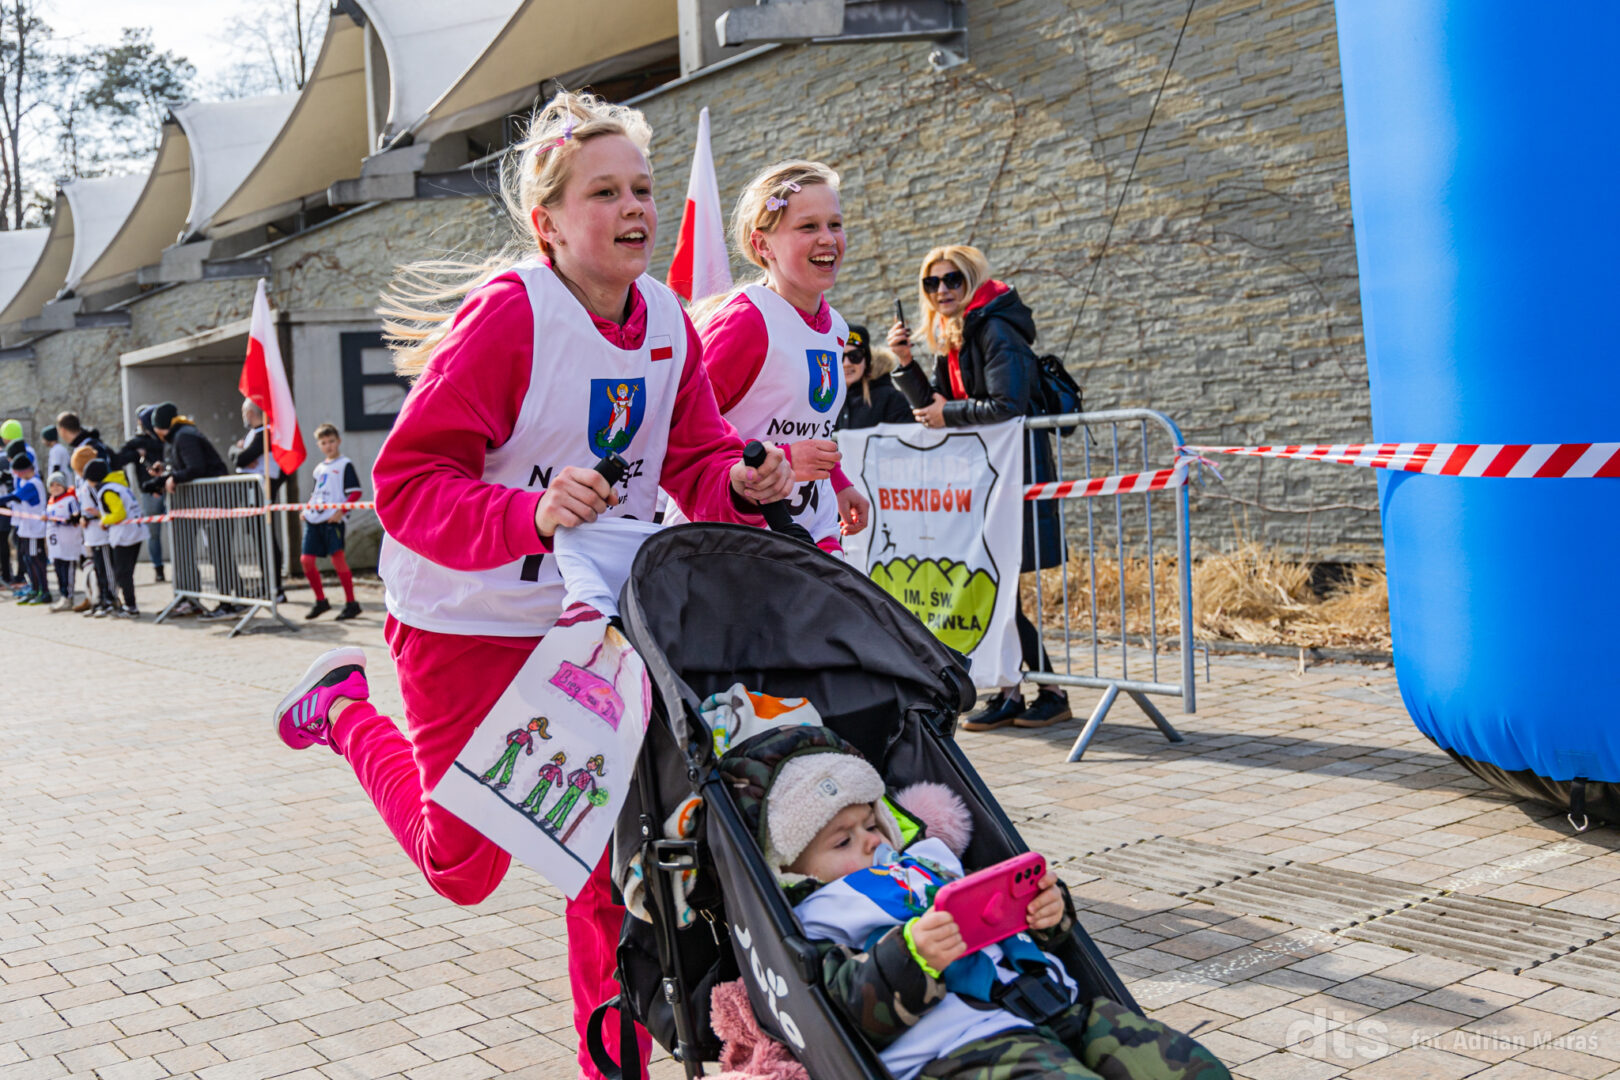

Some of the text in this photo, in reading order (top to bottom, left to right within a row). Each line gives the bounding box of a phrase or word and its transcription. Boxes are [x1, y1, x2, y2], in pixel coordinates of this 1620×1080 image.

[766, 418, 820, 440] Nowy
[878, 483, 972, 513] BESKIDÓW
[904, 587, 953, 609] IM. ŚW.
[927, 612, 982, 632] PAWŁA
